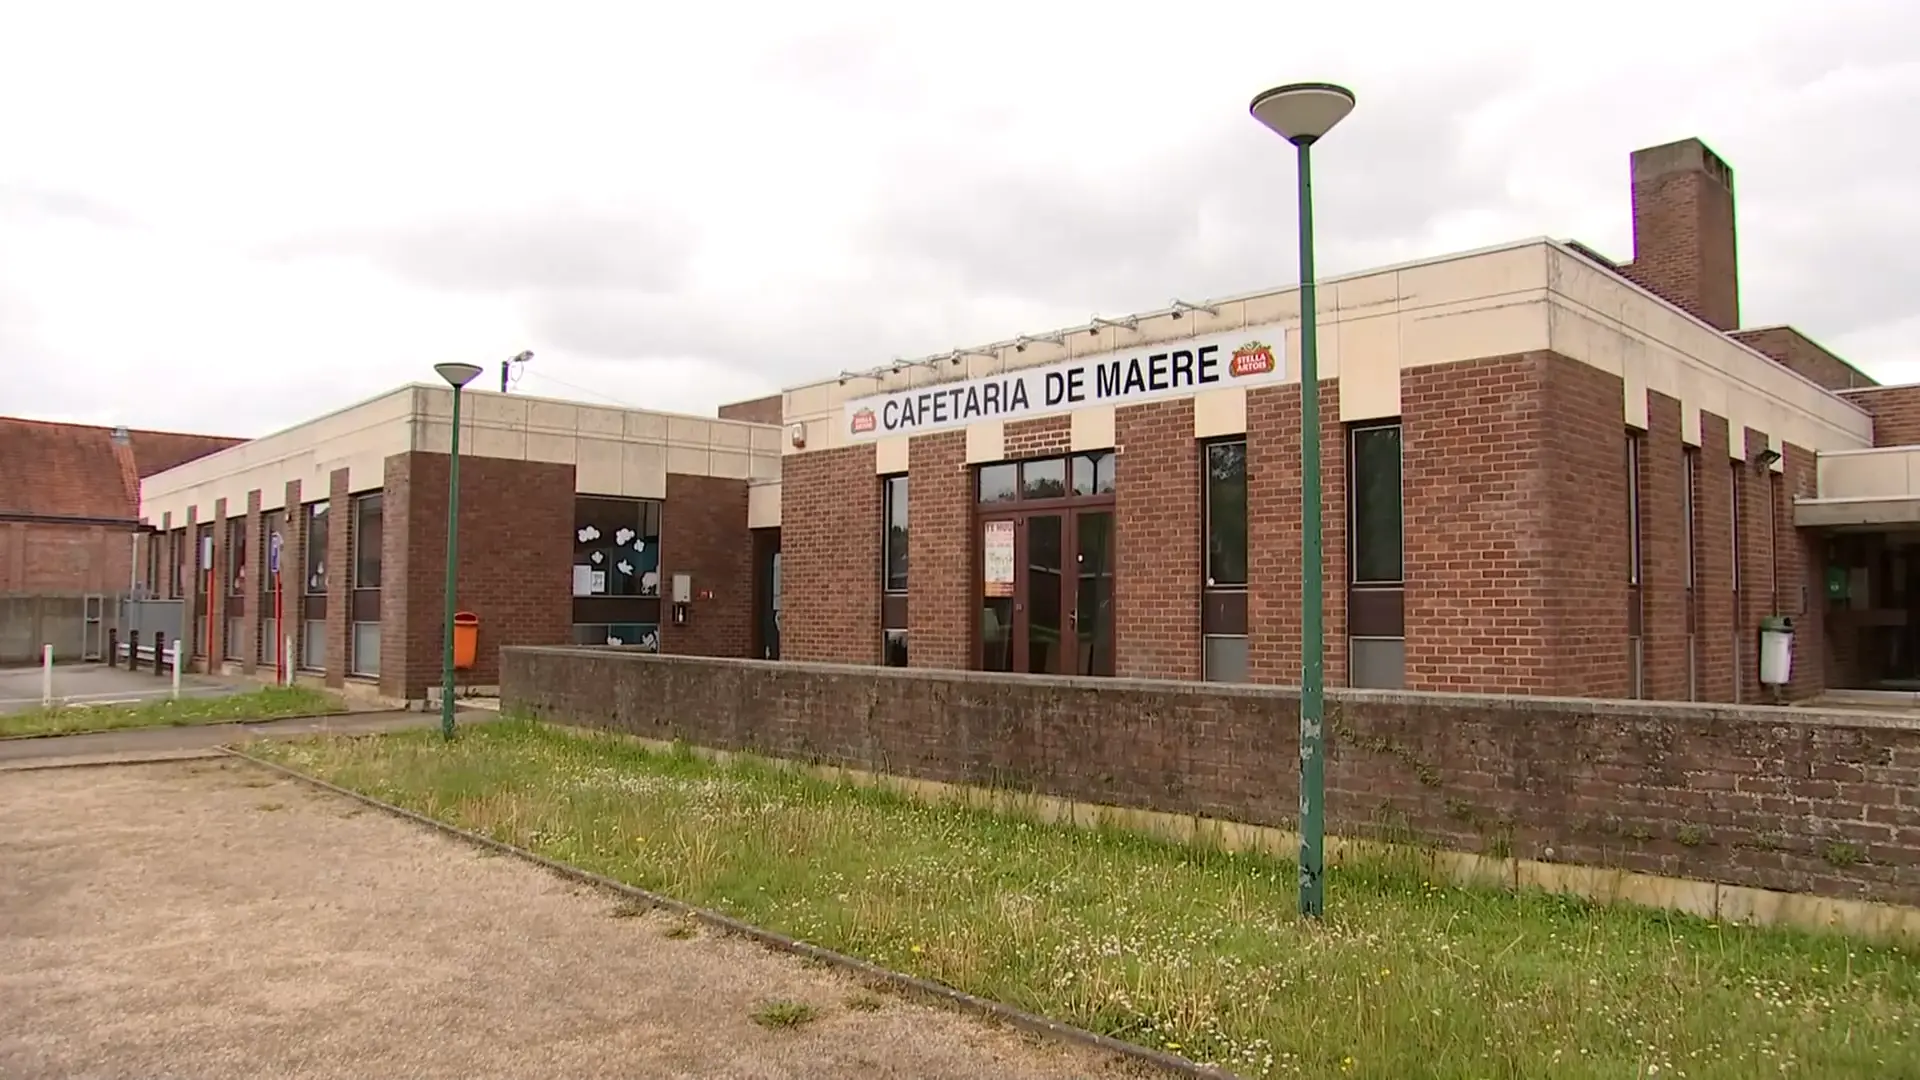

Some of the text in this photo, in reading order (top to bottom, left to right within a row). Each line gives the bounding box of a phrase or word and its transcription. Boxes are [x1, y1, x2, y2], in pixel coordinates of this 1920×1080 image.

[1237, 352, 1266, 364] STELLA
[883, 345, 1219, 430] CAFETARIA DE MAERE
